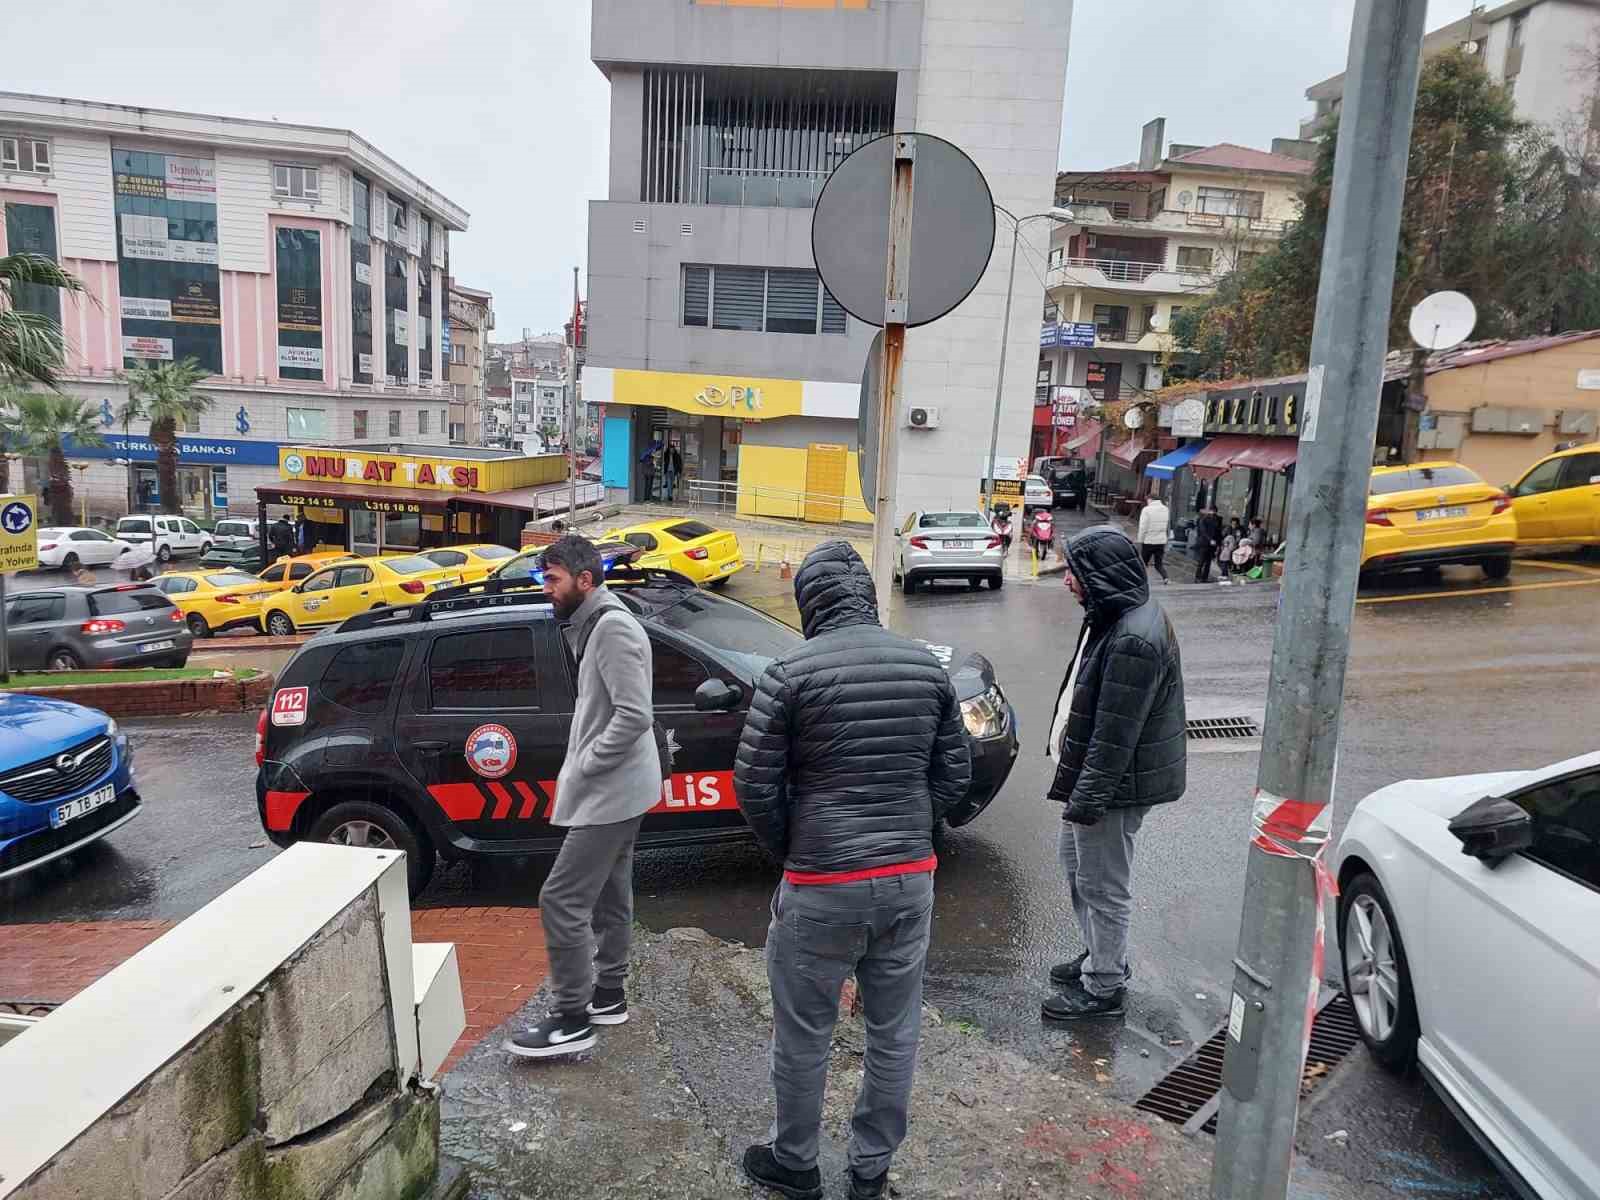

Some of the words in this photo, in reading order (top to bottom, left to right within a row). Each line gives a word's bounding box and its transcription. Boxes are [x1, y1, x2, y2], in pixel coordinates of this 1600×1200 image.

[182, 445, 236, 456] BANKASI
[305, 456, 396, 481] MURAT
[287, 496, 305, 505] 322
[308, 497, 320, 506] 14
[323, 498, 335, 507] 15
[280, 692, 304, 710] 112
[57, 804, 72, 821] 67
[77, 797, 91, 812] TB
[94, 786, 113, 805] 377
